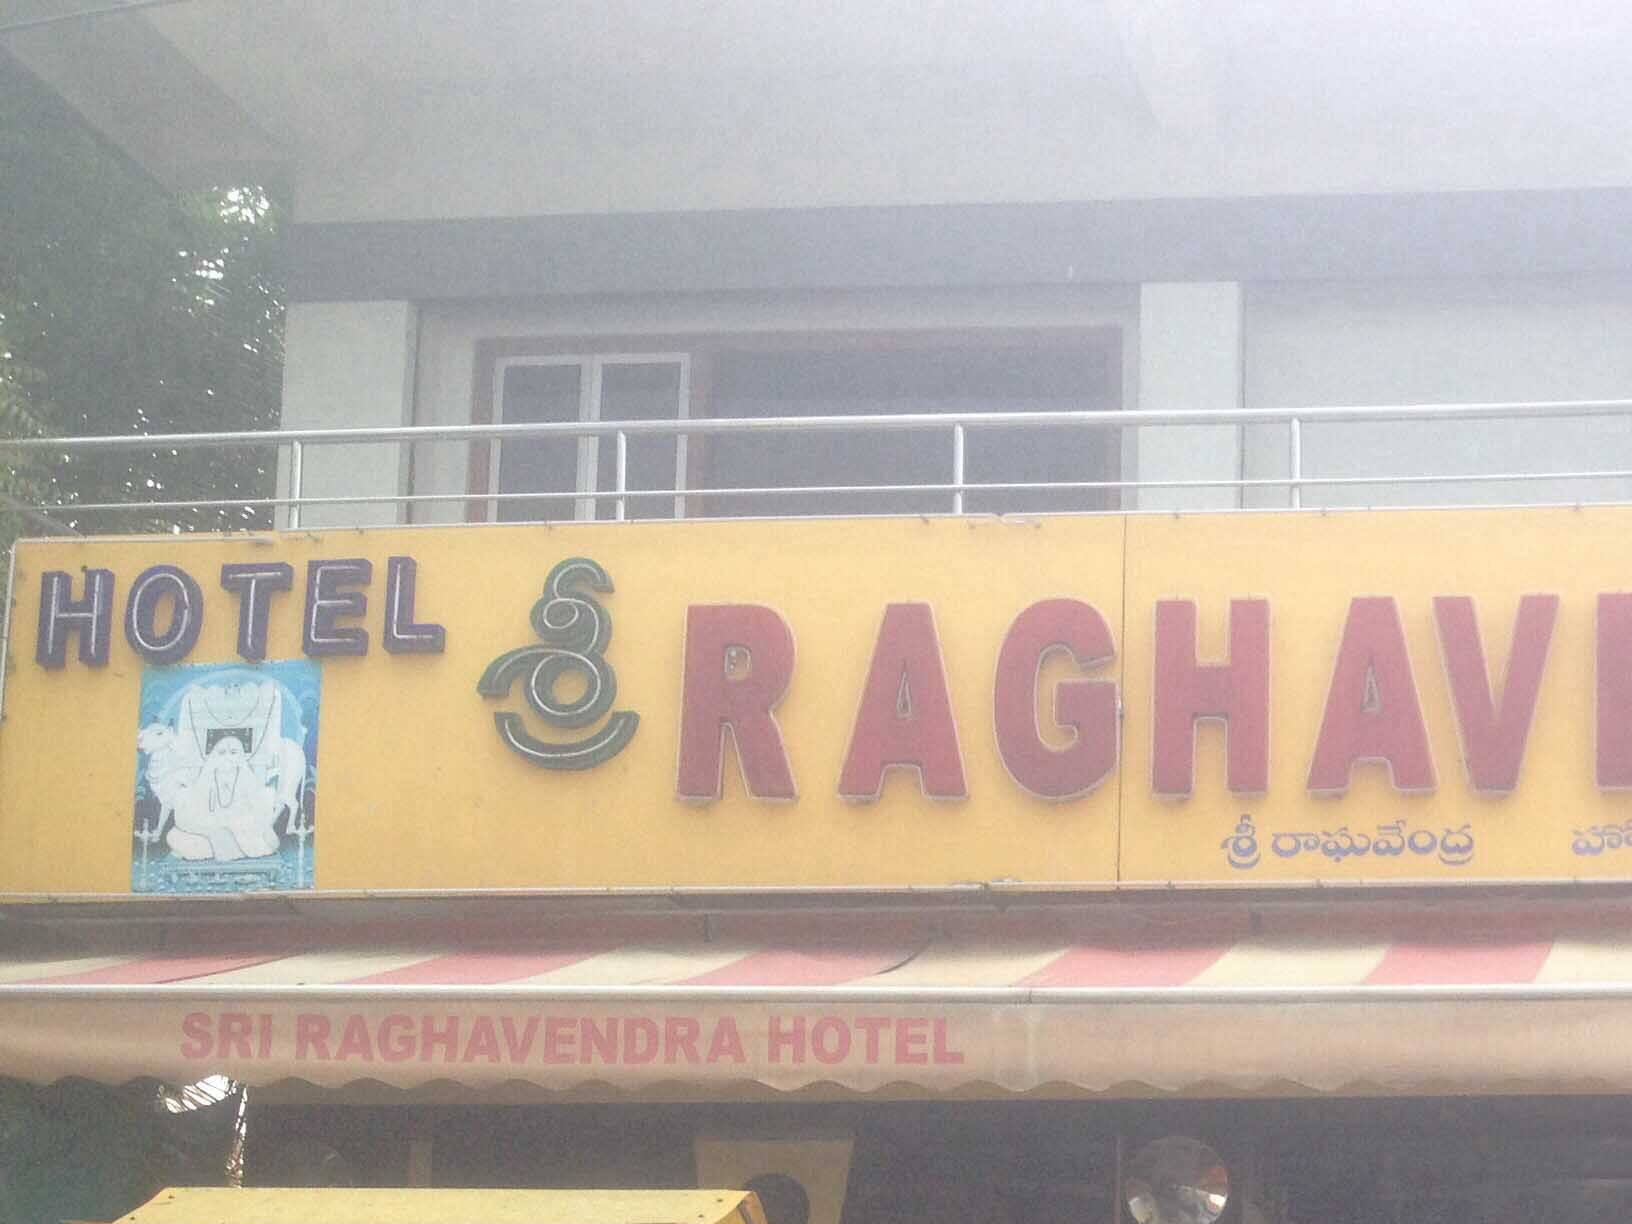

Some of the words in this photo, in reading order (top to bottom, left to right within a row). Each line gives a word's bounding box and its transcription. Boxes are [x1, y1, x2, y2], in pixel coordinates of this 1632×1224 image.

[35, 555, 446, 670] HOTEL
[1271, 819, 1474, 866] రాఘవేంద్ర
[180, 1011, 273, 1061] SRI
[294, 1012, 748, 1065] RAGHAVENDRA
[766, 1015, 965, 1065] HOTEL
